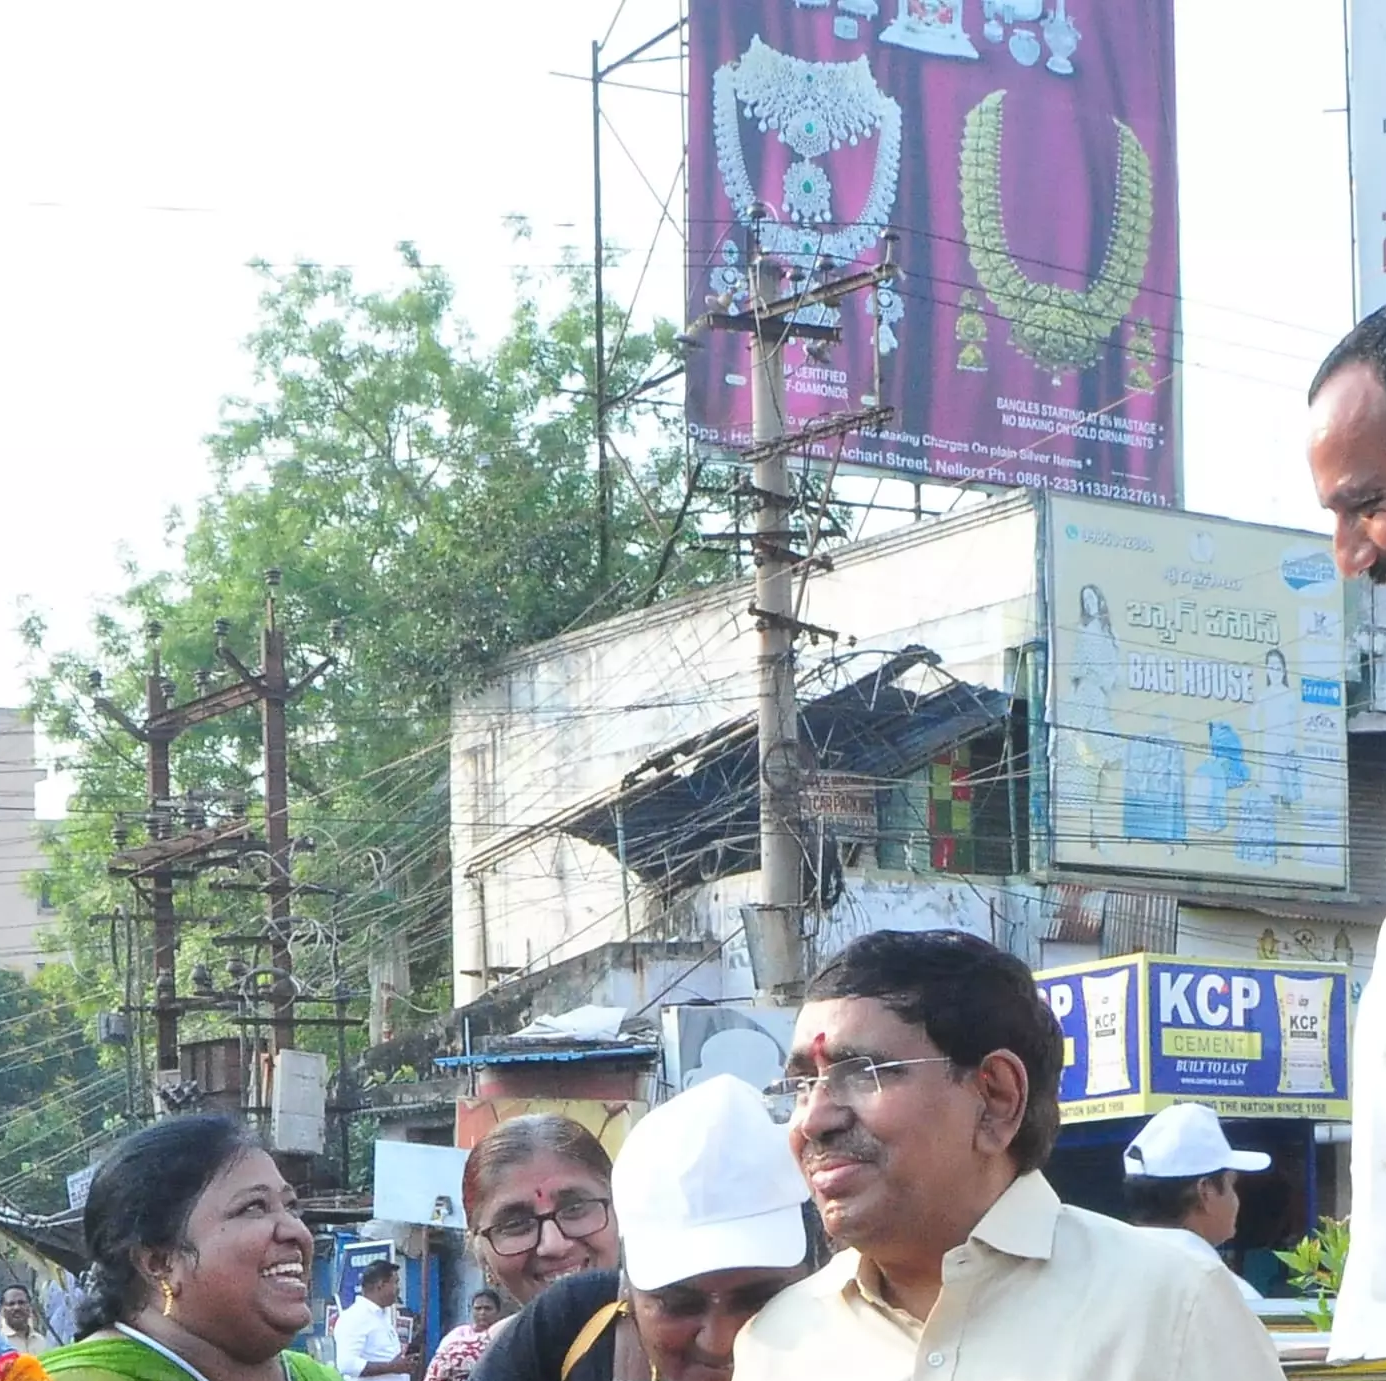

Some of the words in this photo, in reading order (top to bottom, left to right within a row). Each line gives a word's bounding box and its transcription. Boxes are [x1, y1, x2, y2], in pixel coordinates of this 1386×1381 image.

[996, 396, 1040, 415] BANGLES
[1041, 404, 1085, 422] STARTING
[1113, 416, 1156, 435] WASTAGE
[1001, 413, 1016, 426] NO
[1018, 415, 1055, 433] MAKING
[922, 433, 969, 453] Charges
[971, 442, 988, 455] On
[990, 444, 1017, 460] plain
[1019, 447, 1050, 465] Silver
[1053, 454, 1083, 469] Items
[1128, 650, 1176, 695] BAG
[1180, 657, 1255, 704] HOUSE
[1158, 971, 1261, 1028] KCP
[1094, 1012, 1117, 1030] KCP
[1289, 1014, 1319, 1031] KCP
[1173, 1034, 1246, 1054] CEMENT
[1175, 1059, 1207, 1074] BUILT
[1208, 1060, 1223, 1074] TO
[1223, 1061, 1249, 1076] LAST
[1220, 1100, 1238, 1112] THE
[1241, 1101, 1275, 1113] NATION
[1277, 1102, 1305, 1114] SINCE
